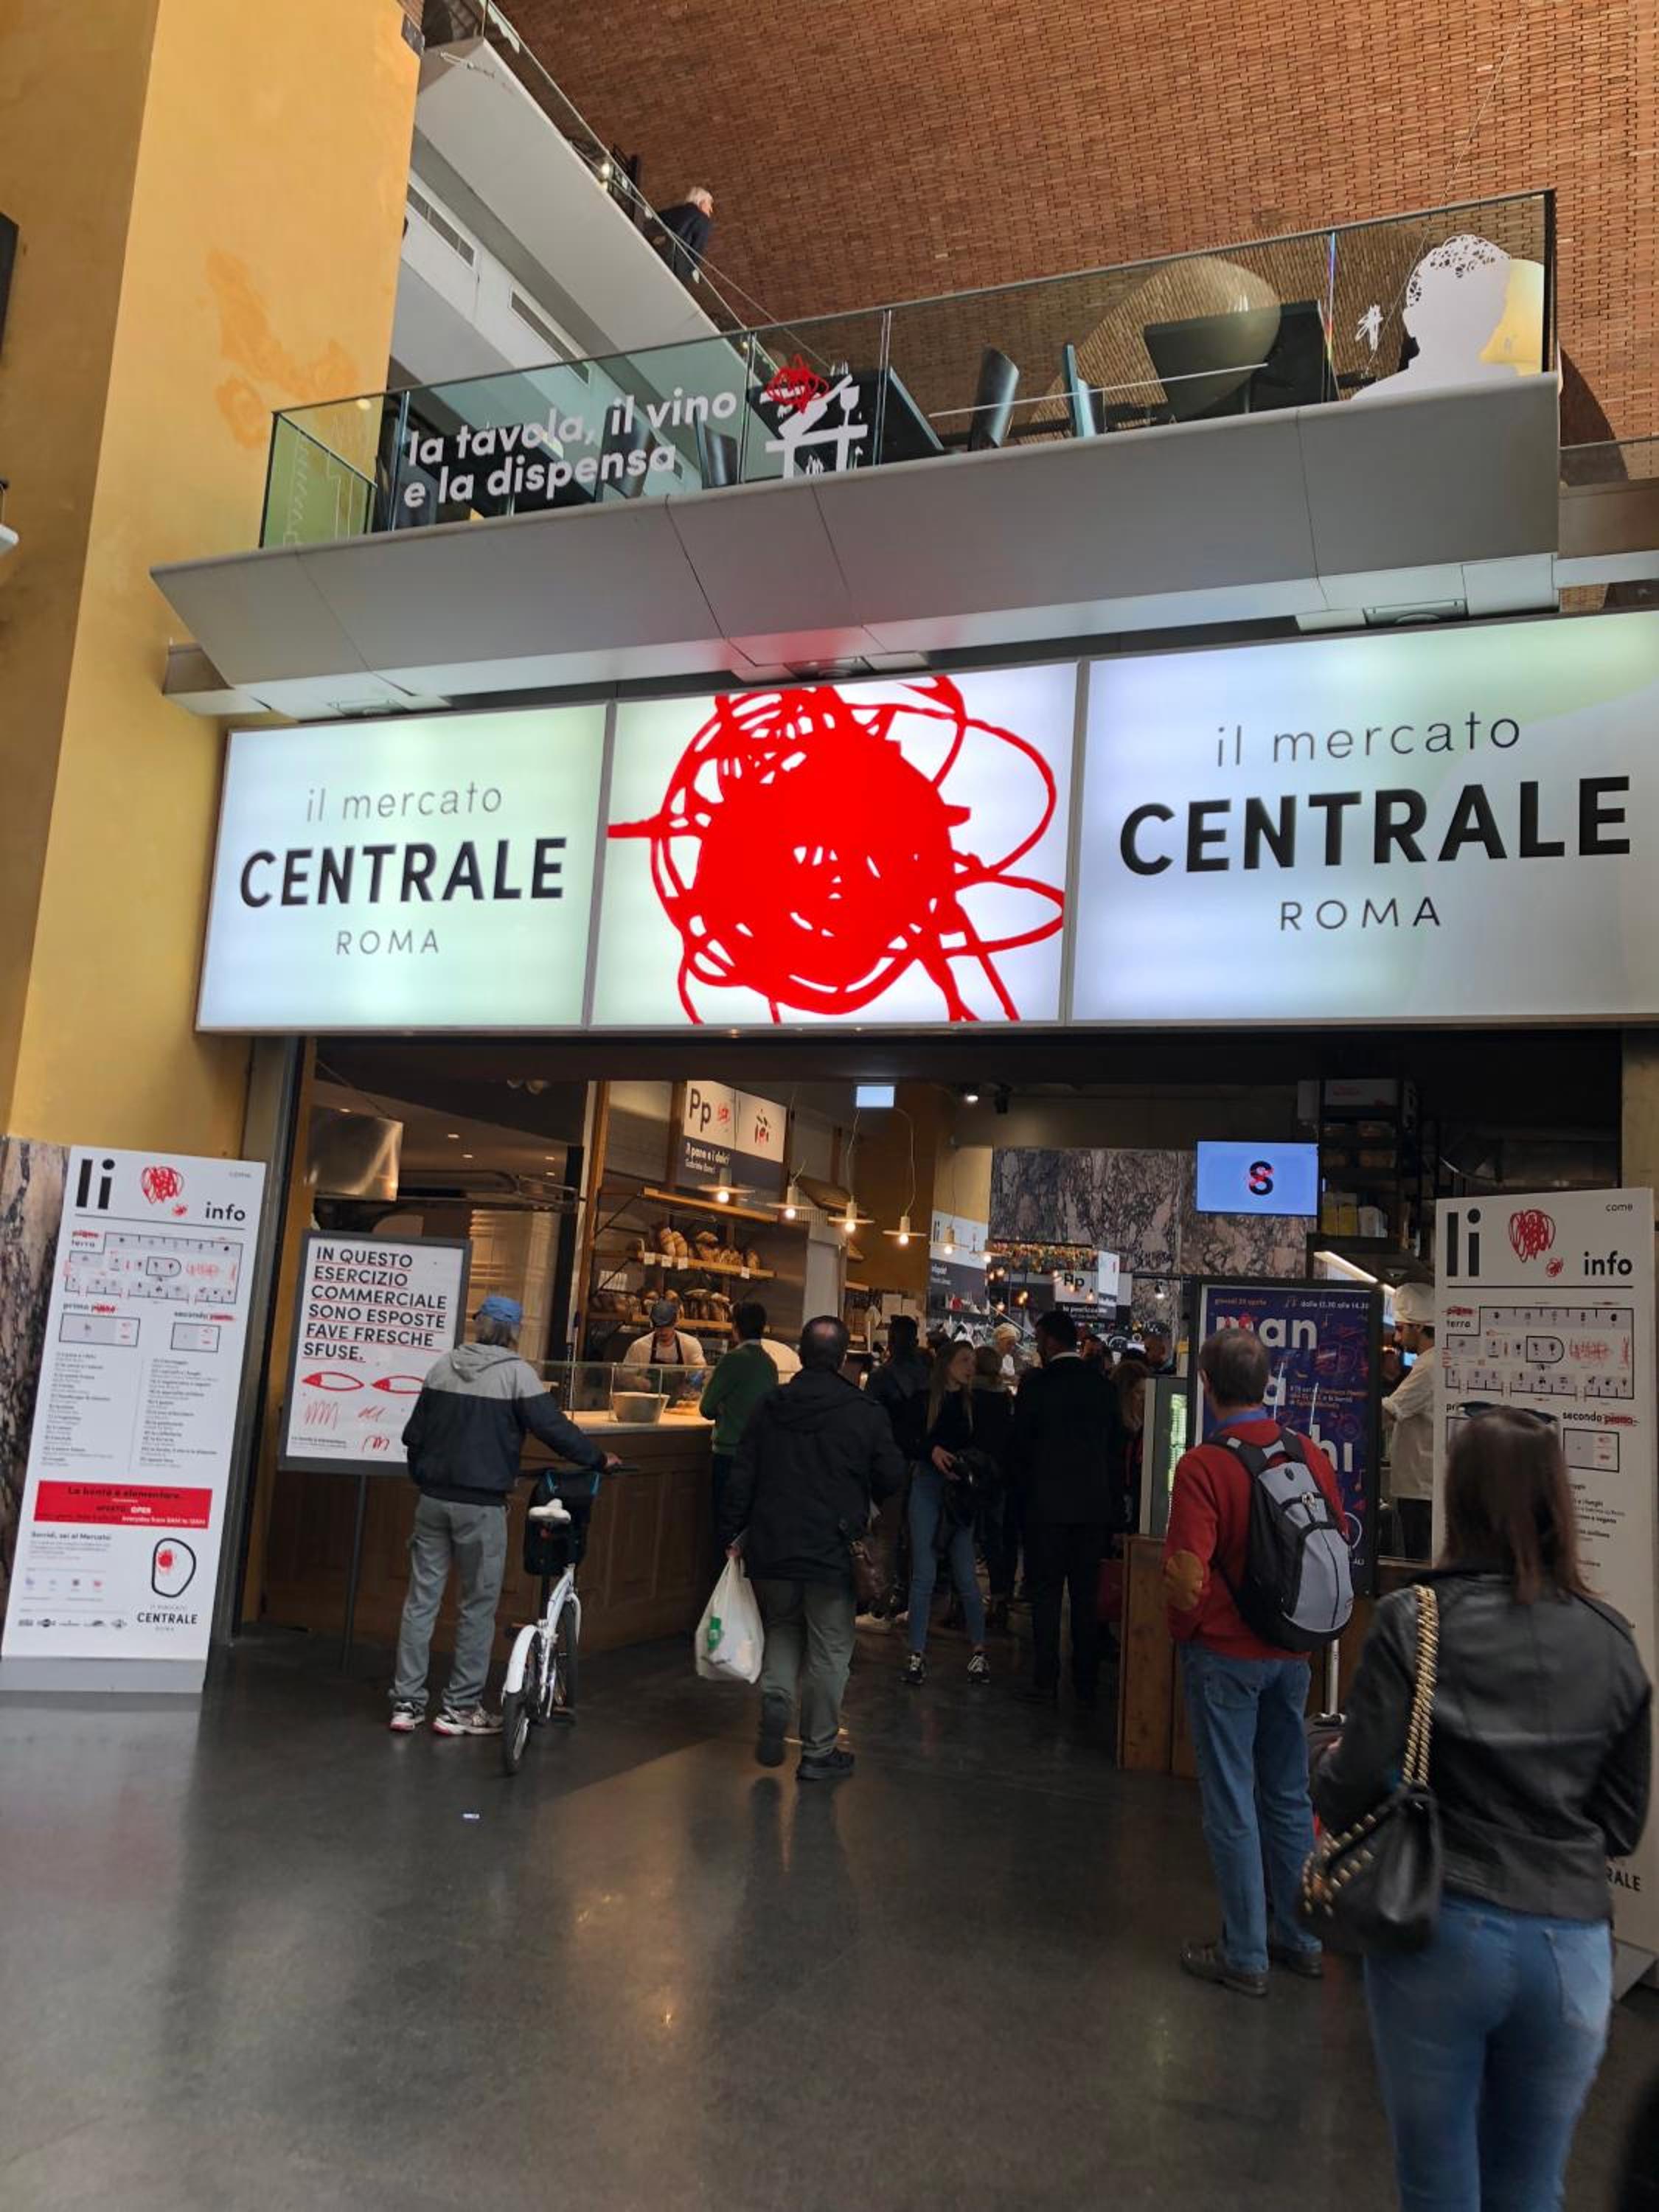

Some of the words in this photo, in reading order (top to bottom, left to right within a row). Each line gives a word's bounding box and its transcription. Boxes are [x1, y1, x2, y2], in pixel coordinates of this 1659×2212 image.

[408, 431, 442, 467] la
[456, 410, 595, 462] tavola,
[611, 391, 635, 437] il
[647, 387, 736, 429] vino
[404, 484, 424, 509] e
[438, 466, 474, 504] la
[487, 445, 676, 501] dispensa
[1216, 725, 1242, 767] il
[1273, 711, 1520, 762] mercato
[306, 788, 326, 821] il
[342, 782, 502, 820] mercato
[1119, 775, 1631, 876] CENTRALE
[240, 837, 567, 908] CENTRALE
[1279, 897, 1441, 931] ROMA
[335, 928, 439, 956] ROMA
[689, 1088, 712, 1133] Pp
[205, 1202, 246, 1221] info
[1605, 1203, 1633, 1211] come
[316, 1246, 334, 1262] IN
[340, 1248, 413, 1267] QUESTO
[1584, 1251, 1633, 1277] info
[313, 1265, 408, 1287] ESERCIZIO
[311, 1284, 447, 1310] COMMERCIALE
[308, 1304, 362, 1321] SONO
[366, 1308, 446, 1329] ESPOSTE
[1446, 1319, 1471, 1329] terra
[306, 1323, 349, 1340] FAVE
[354, 1326, 434, 1347] FRESCHE
[303, 1342, 364, 1361] SFUSE.
[1562, 1411, 1601, 1422] secondo
[136, 1612, 198, 1624] CENTRALE
[1606, 1865, 1641, 1892] RALE
